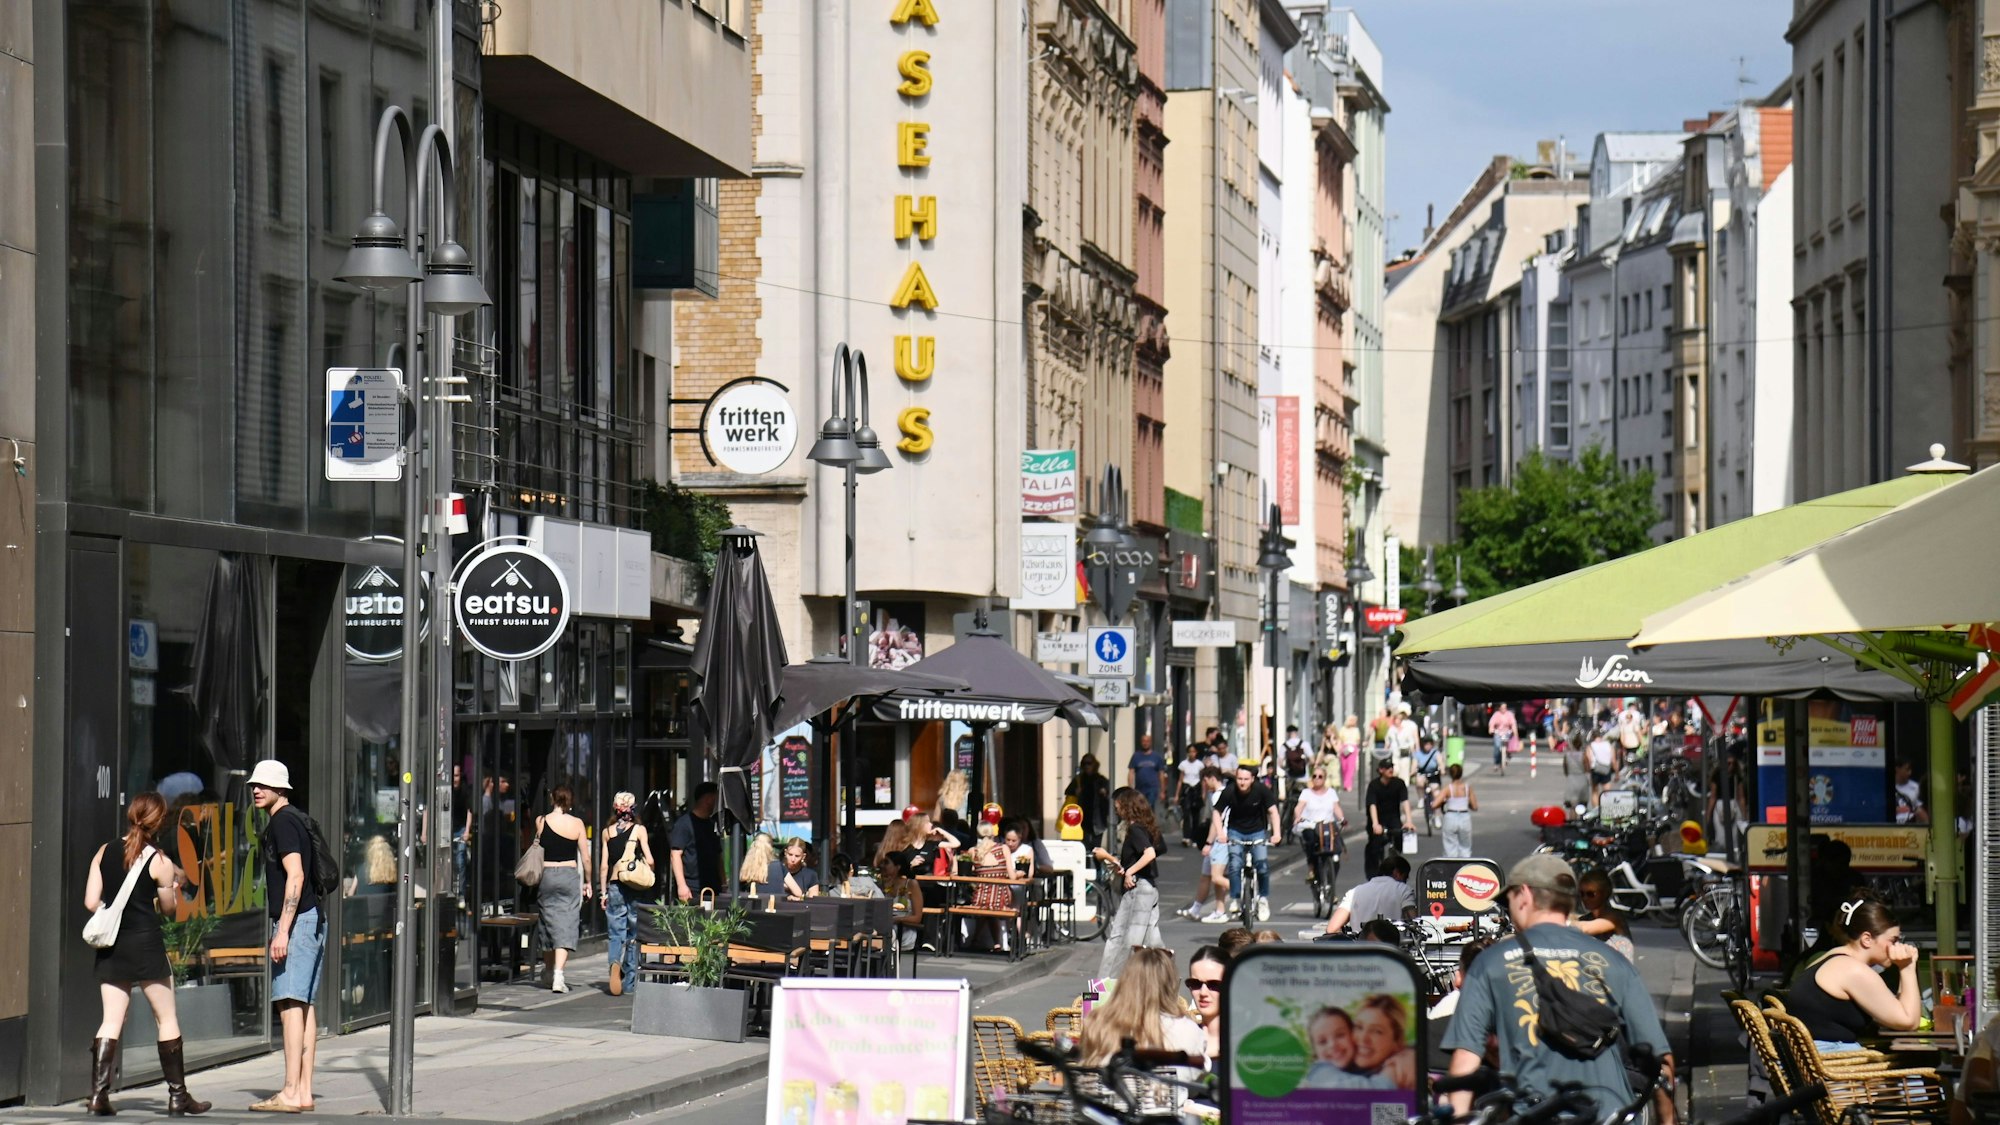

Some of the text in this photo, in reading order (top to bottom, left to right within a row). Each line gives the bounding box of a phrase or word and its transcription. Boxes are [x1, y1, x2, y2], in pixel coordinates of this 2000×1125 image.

[719, 407, 785, 426] fritten
[726, 422, 779, 442] werk
[465, 592, 558, 614] eatsu.
[470, 618, 549, 626] FINEST SUSHI BAR
[1177, 629, 1231, 639] HOLZKERN
[1098, 664, 1123, 673] ZONE
[1575, 654, 1654, 689] Sion
[900, 699, 1026, 722] frittenwerk
[1853, 719, 1876, 733] Bild
[97, 765, 111, 799] 100
[1426, 880, 1430, 889] I
[1431, 881, 1447, 889] was
[1426, 890, 1448, 899] here!
